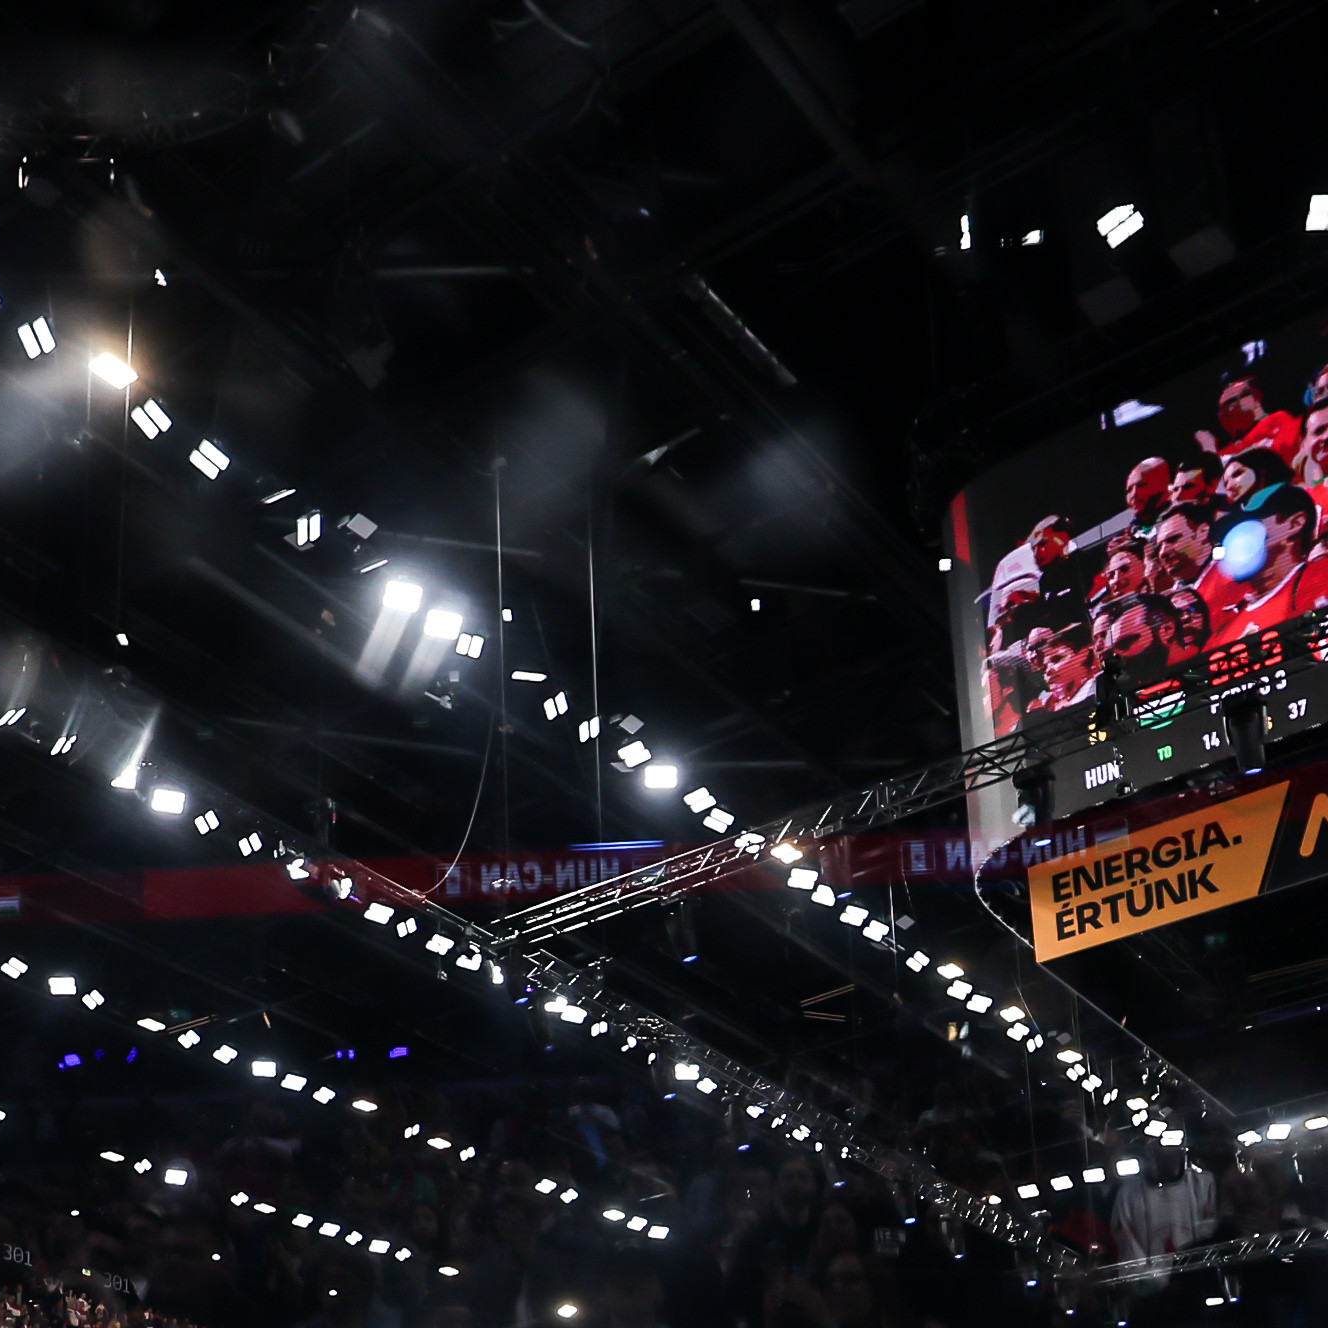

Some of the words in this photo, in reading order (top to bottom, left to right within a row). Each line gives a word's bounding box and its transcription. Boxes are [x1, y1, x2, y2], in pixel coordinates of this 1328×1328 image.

[1288, 699, 1307, 720] 37
[1157, 745, 1172, 760] TO
[1202, 732, 1220, 750] 14
[1085, 761, 1120, 789] HUN
[1052, 823, 1243, 904] ENERGIA.
[1055, 862, 1219, 942] ÉRTÜNK
[3, 1244, 34, 1268] 301
[103, 1272, 132, 1294] 301
